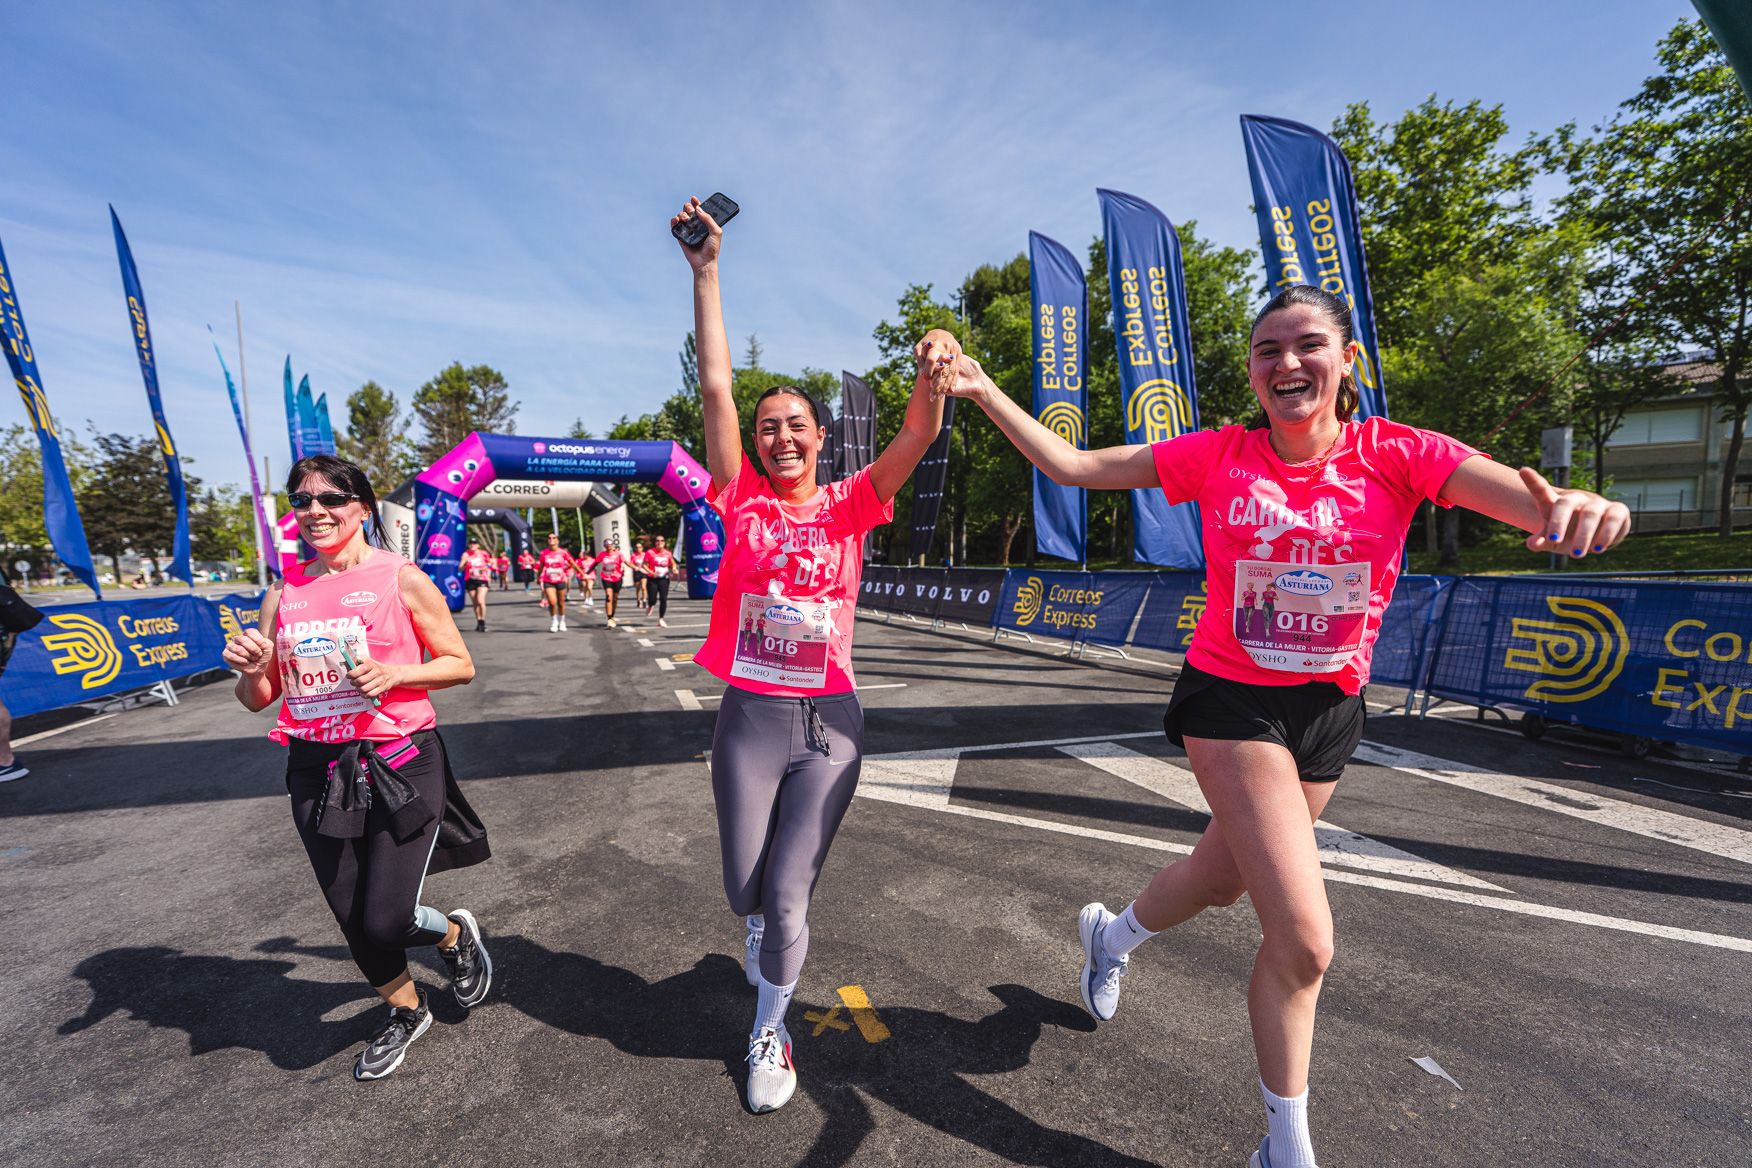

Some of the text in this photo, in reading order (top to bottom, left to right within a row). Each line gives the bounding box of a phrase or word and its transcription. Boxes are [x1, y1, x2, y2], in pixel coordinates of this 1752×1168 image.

[527, 457, 636, 468] LA ENERGÍA PARA CORRER
[548, 466, 595, 474] VELOCIDAD
[493, 484, 551, 495] CORREO
[611, 520, 619, 532] EL
[1247, 570, 1273, 578] SUMA
[1279, 577, 1329, 591] ASTURIANA
[916, 584, 991, 605] VOLVO
[1049, 584, 1104, 606] Correos
[767, 610, 801, 622] ASTURIANA
[1043, 605, 1097, 630] Express
[1276, 612, 1329, 633] 016
[118, 615, 180, 639] Correos
[1293, 633, 1311, 643] 944
[1664, 619, 1752, 664] Co
[764, 636, 798, 655] 016
[1284, 644, 1306, 652] MUJER
[129, 641, 189, 669] Express
[1314, 659, 1348, 667] Santander
[302, 670, 339, 687] 016
[741, 665, 815, 684] OYSHO Santander
[315, 686, 333, 694] 1005
